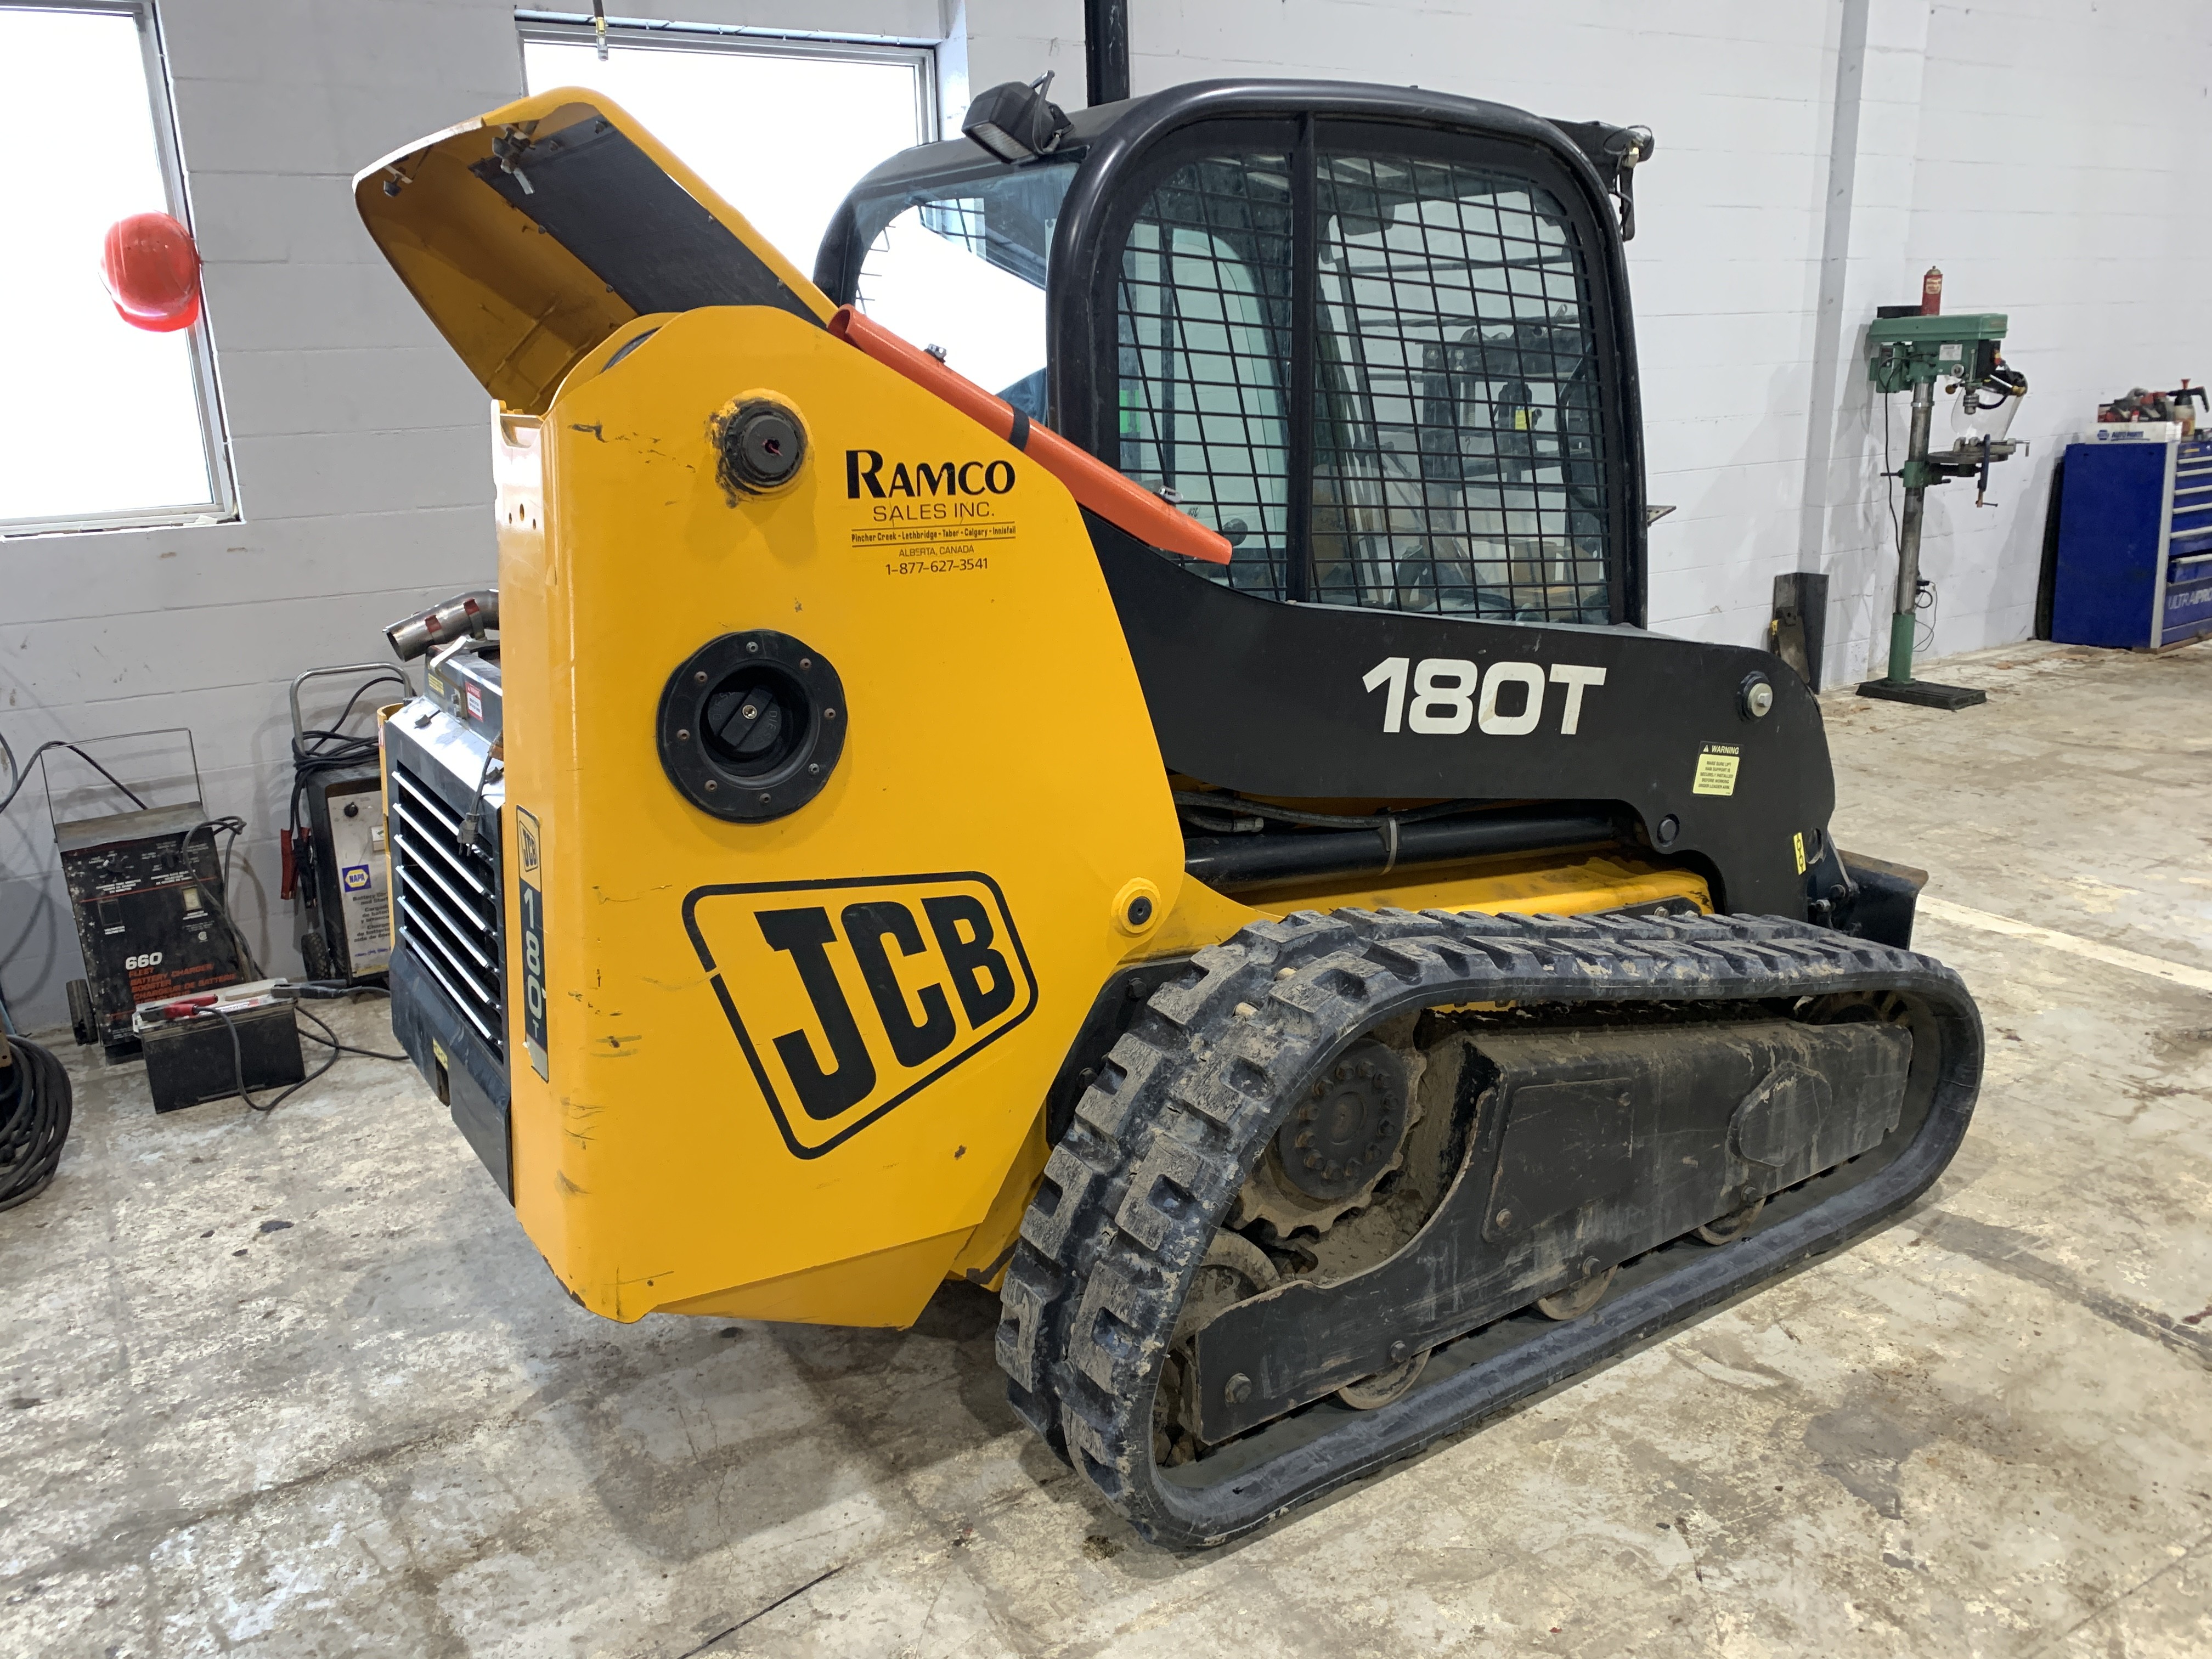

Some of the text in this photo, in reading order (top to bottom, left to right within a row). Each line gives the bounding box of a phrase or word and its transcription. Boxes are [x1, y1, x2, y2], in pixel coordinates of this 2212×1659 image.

[845, 449, 1015, 499] RAMCO
[873, 501, 995, 522] SALES INC.
[851, 533, 876, 542] Pincher
[878, 532, 896, 540] Creek
[902, 529, 937, 540] Lethbridge
[943, 528, 959, 538] Taber
[964, 527, 988, 538] Calgary
[899, 545, 974, 557] ALBERTA, CANADA
[885, 557, 988, 575] 1-877-627-3541
[1362, 657, 1607, 735] 180T
[1711, 745, 1740, 754] WARNING
[522, 827, 537, 867] JCB
[349, 873, 365, 883] NAPA
[126, 952, 162, 970] 660
[129, 967, 154, 978] FLEET
[131, 973, 168, 986] BATTERY
[132, 979, 171, 992] BOOSTER
[133, 985, 181, 1000] CHARGEUR
[184, 981, 195, 990] DE
[753, 895, 1015, 1120] JCB
